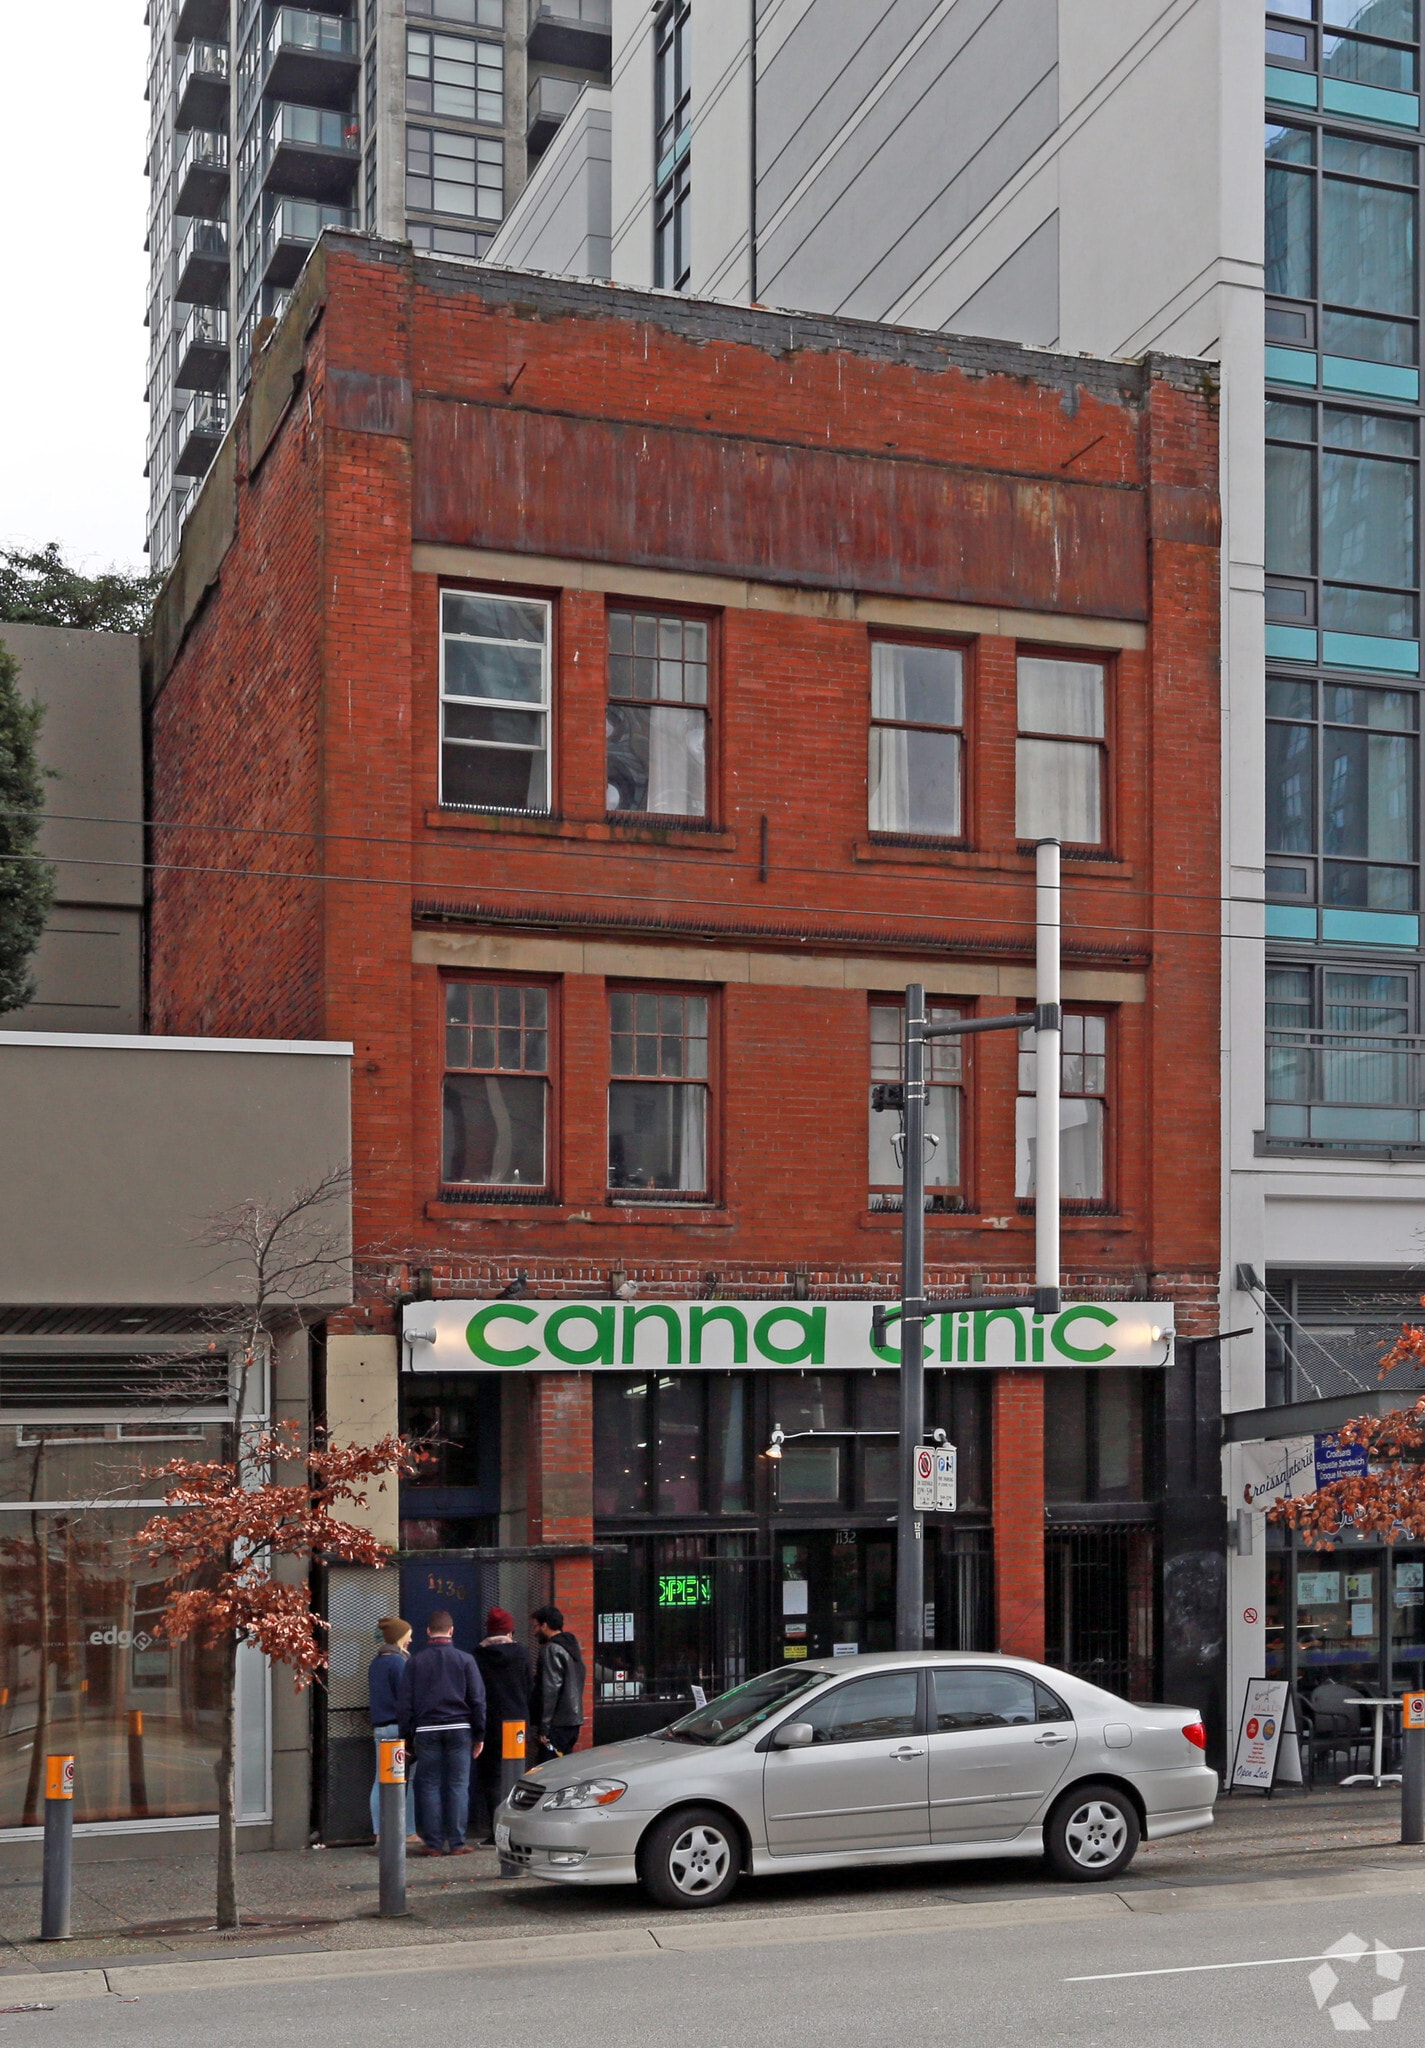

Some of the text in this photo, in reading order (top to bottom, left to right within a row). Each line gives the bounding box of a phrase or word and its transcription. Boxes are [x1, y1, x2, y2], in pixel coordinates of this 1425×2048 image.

[466, 1303, 1119, 1367] canna clinic
[914, 1521, 921, 1530] 12
[836, 1531, 856, 1544] 1132
[89, 1625, 152, 1651] edge
[1236, 1765, 1252, 1778] Open
